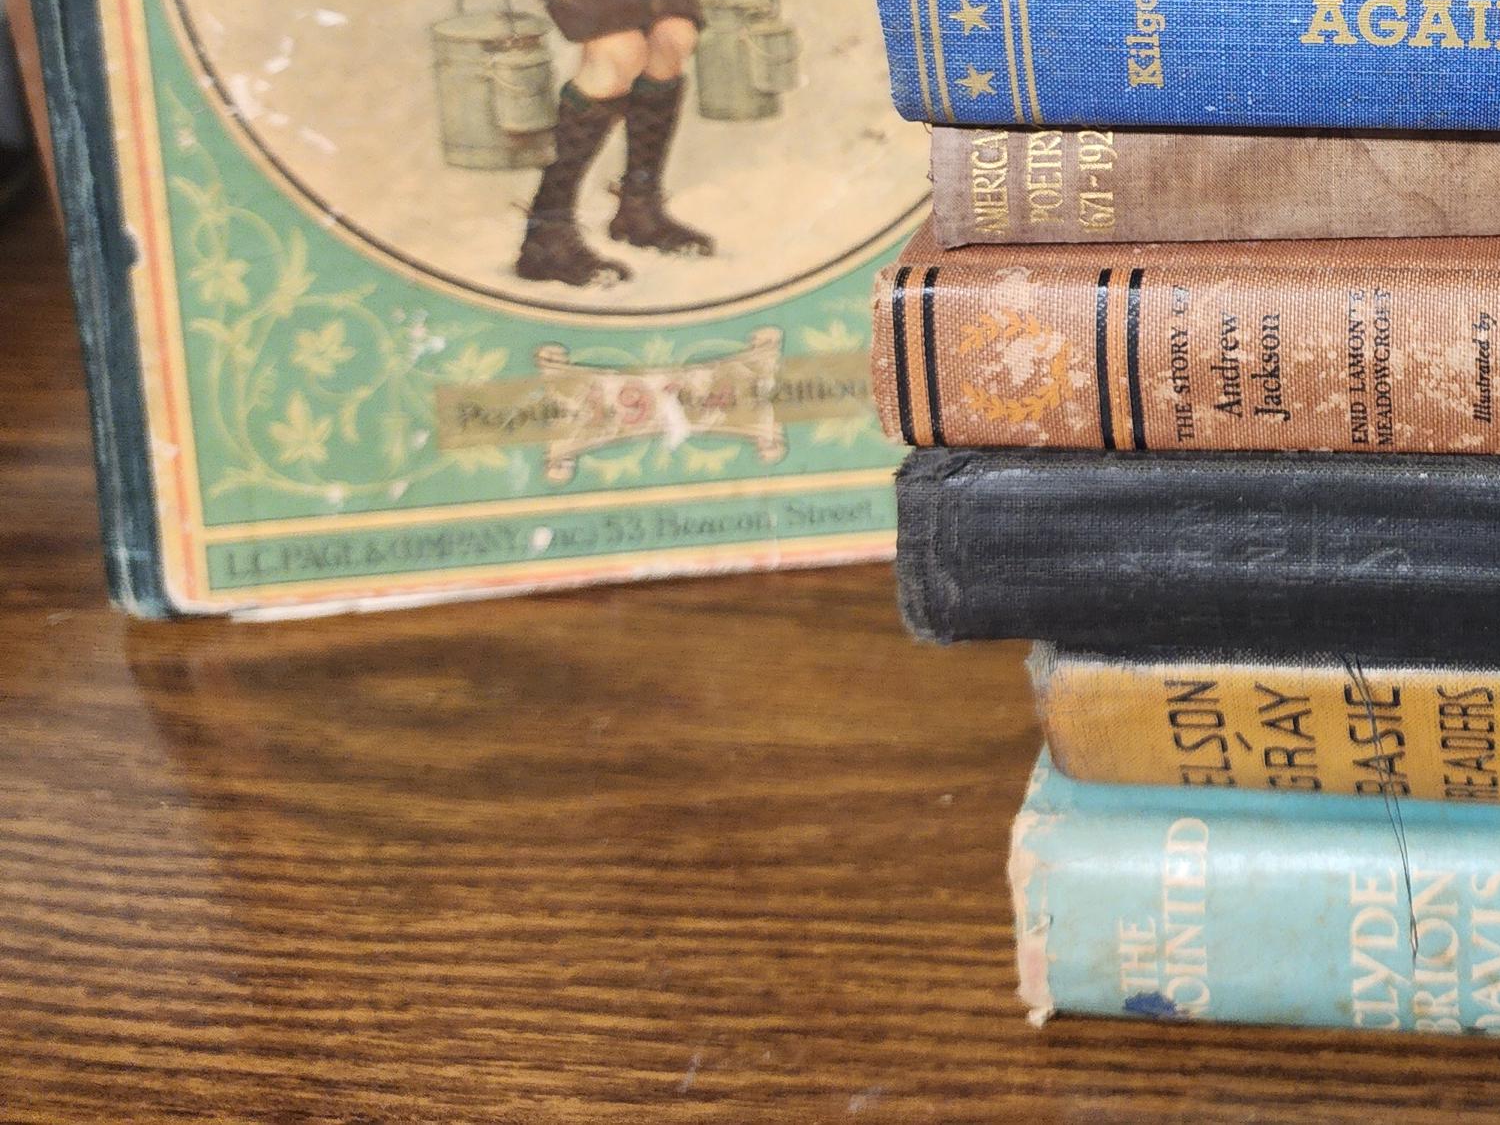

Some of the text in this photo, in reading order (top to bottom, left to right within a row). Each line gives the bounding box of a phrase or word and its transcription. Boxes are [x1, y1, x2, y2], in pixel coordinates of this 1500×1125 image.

[970, 129, 1010, 237] AMERICA
[1170, 326, 1192, 395] STORY
[1211, 310, 1244, 418] Andrew
[1250, 313, 1292, 422] Jackson
[1348, 288, 1370, 446] ENID LAMONE
[1472, 311, 1498, 424] Illustrated by
[1174, 402, 1196, 443] THE
[1436, 684, 1499, 800] READERS
[1117, 914, 1161, 994] THE
[1162, 816, 1211, 1017] OINTED
